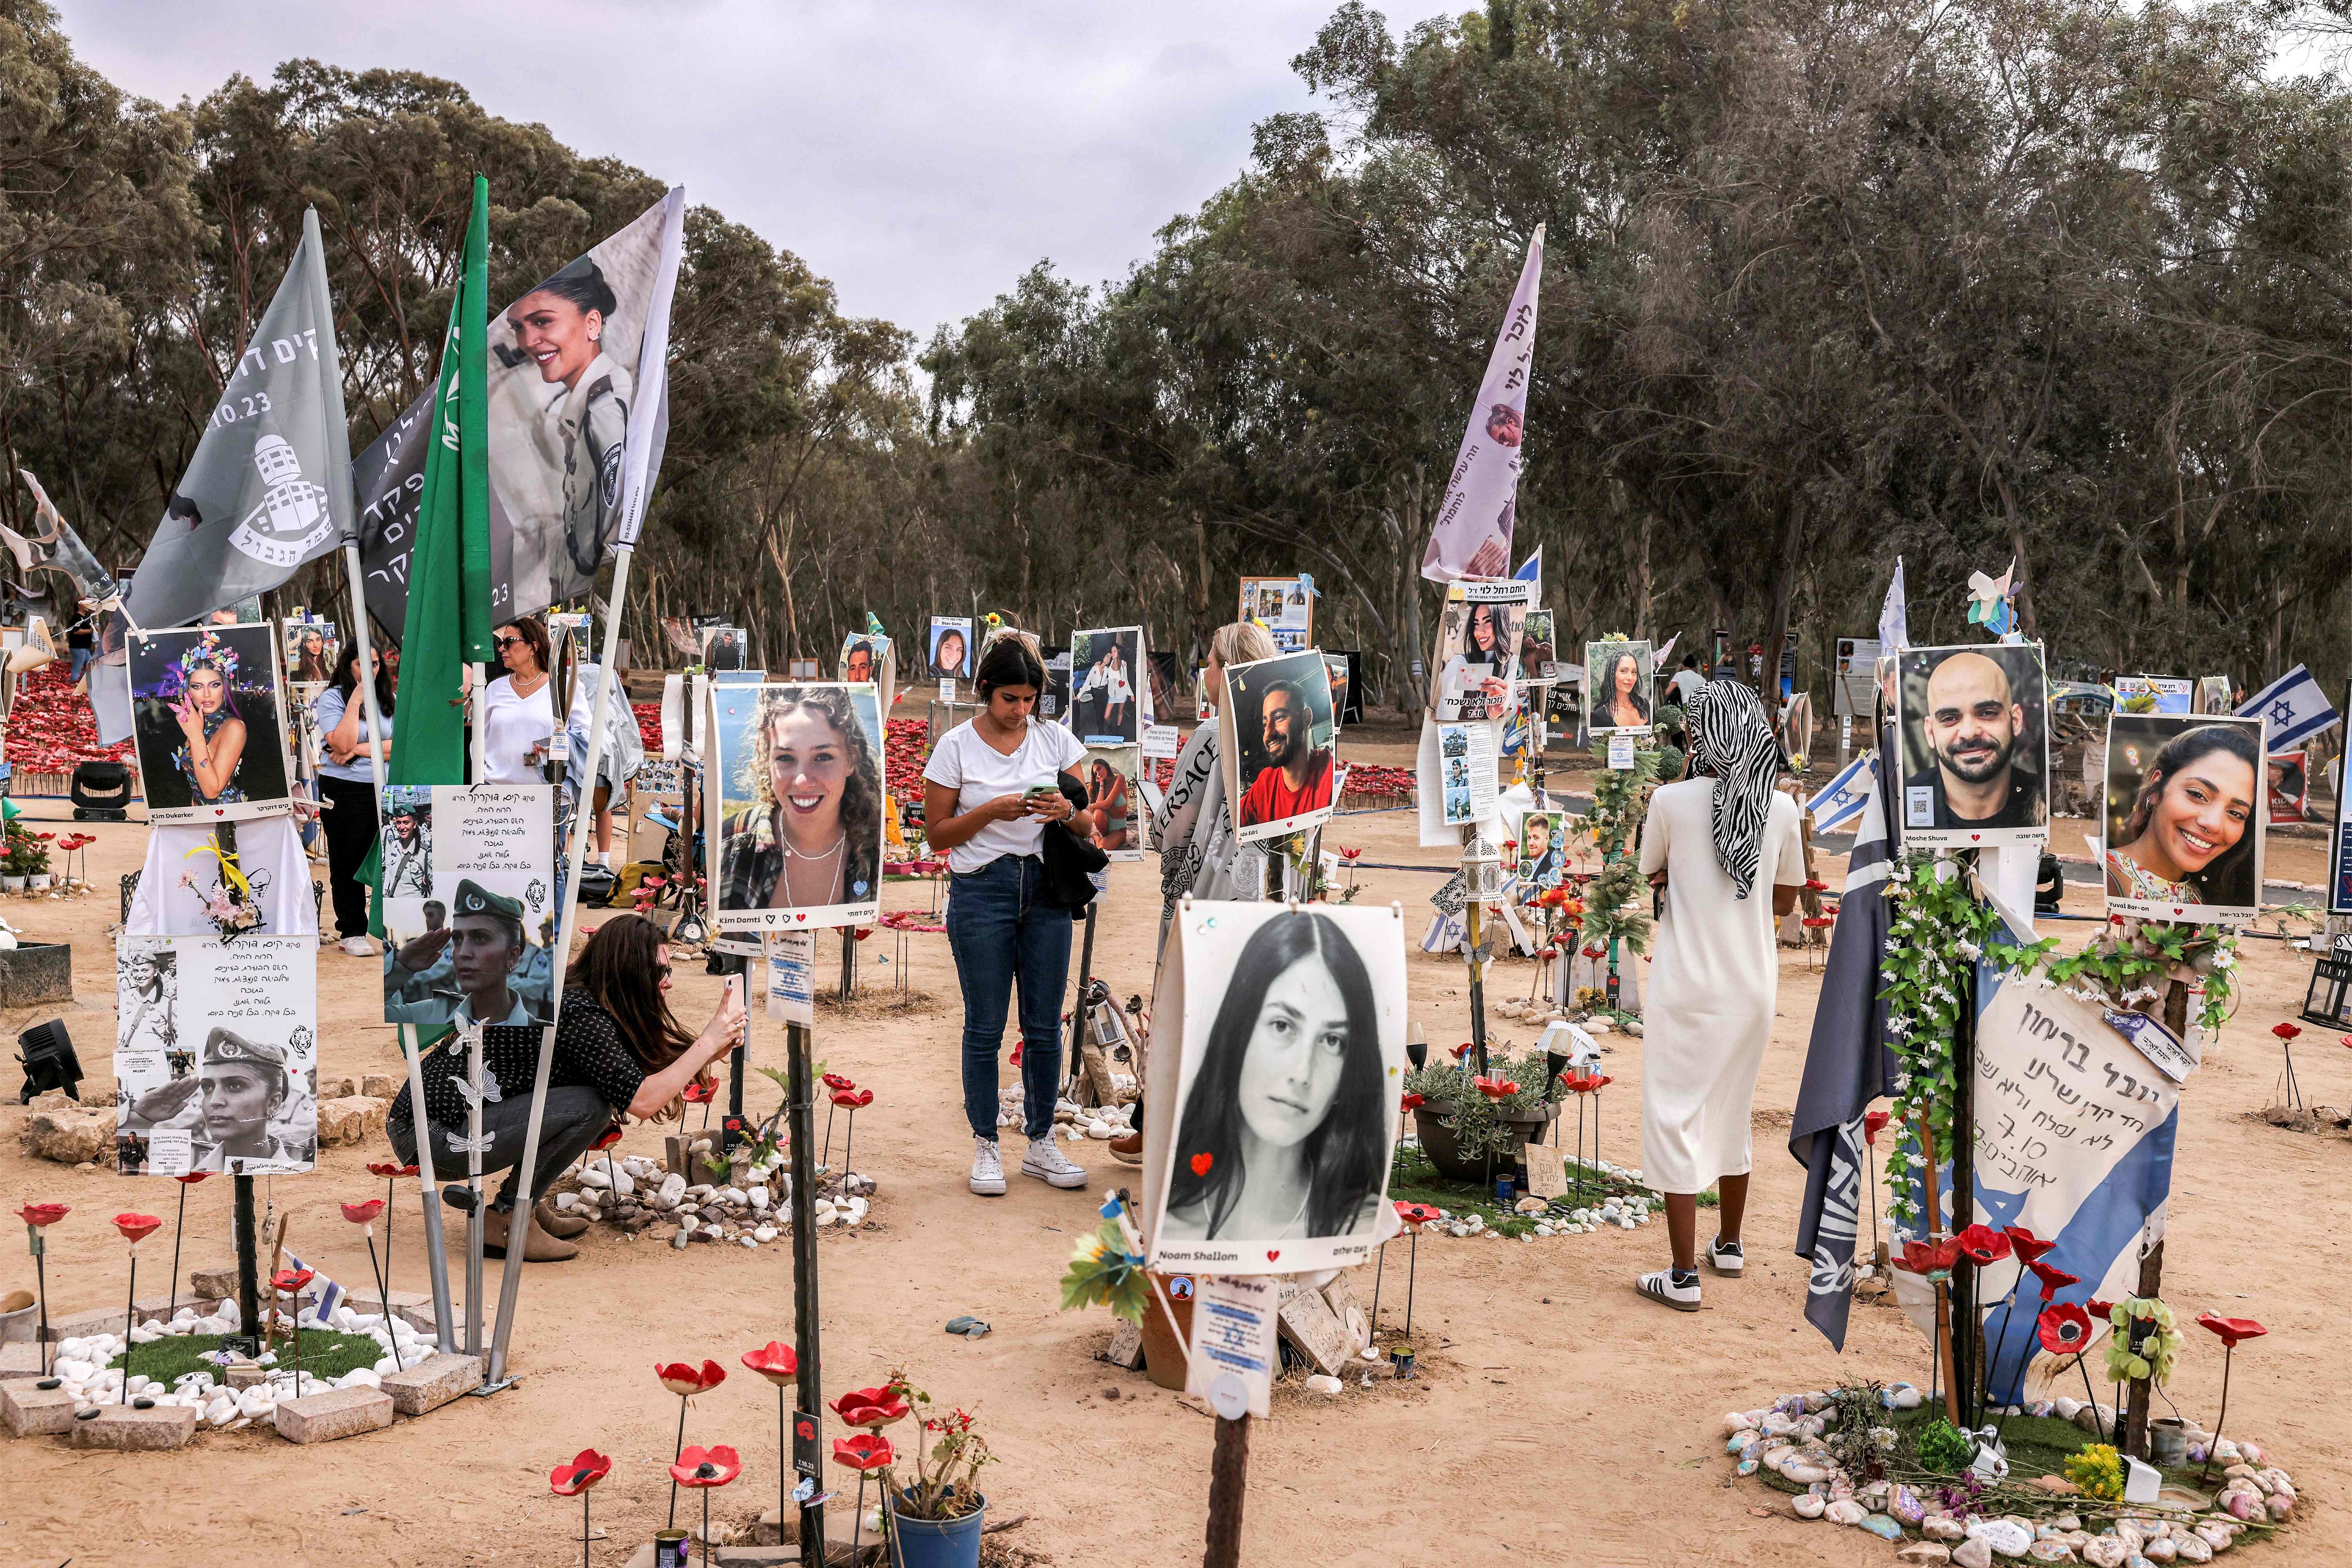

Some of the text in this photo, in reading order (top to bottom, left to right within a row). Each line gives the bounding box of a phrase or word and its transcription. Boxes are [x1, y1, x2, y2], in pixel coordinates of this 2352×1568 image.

[1504, 304, 1532, 343] לזכר
[1504, 368, 1524, 390] לוי
[1450, 461, 1468, 488] עושה
[624, 509, 635, 539] 03-5334444
[241, 530, 296, 563] הגבול
[1480, 585, 1491, 594] לוי
[1494, 585, 1508, 594] רחל
[1510, 585, 1525, 593] רותם
[1472, 697, 1486, 706] ולא
[1547, 700, 1577, 711] מחכים לך
[503, 794, 520, 804] קים
[495, 850, 510, 858] תלווה
[263, 940, 282, 950] קים
[2103, 1062, 2160, 1102] יובל
[1996, 1078, 2031, 1110] ולא
[2032, 1110, 2076, 1138] נסלח
[2081, 1134, 2113, 1150] לא
[1158, 1250, 1238, 1261] Noam Shallom
[1333, 1247, 1354, 1256] שלום
[798, 1459, 814, 1469] 7.10.23
